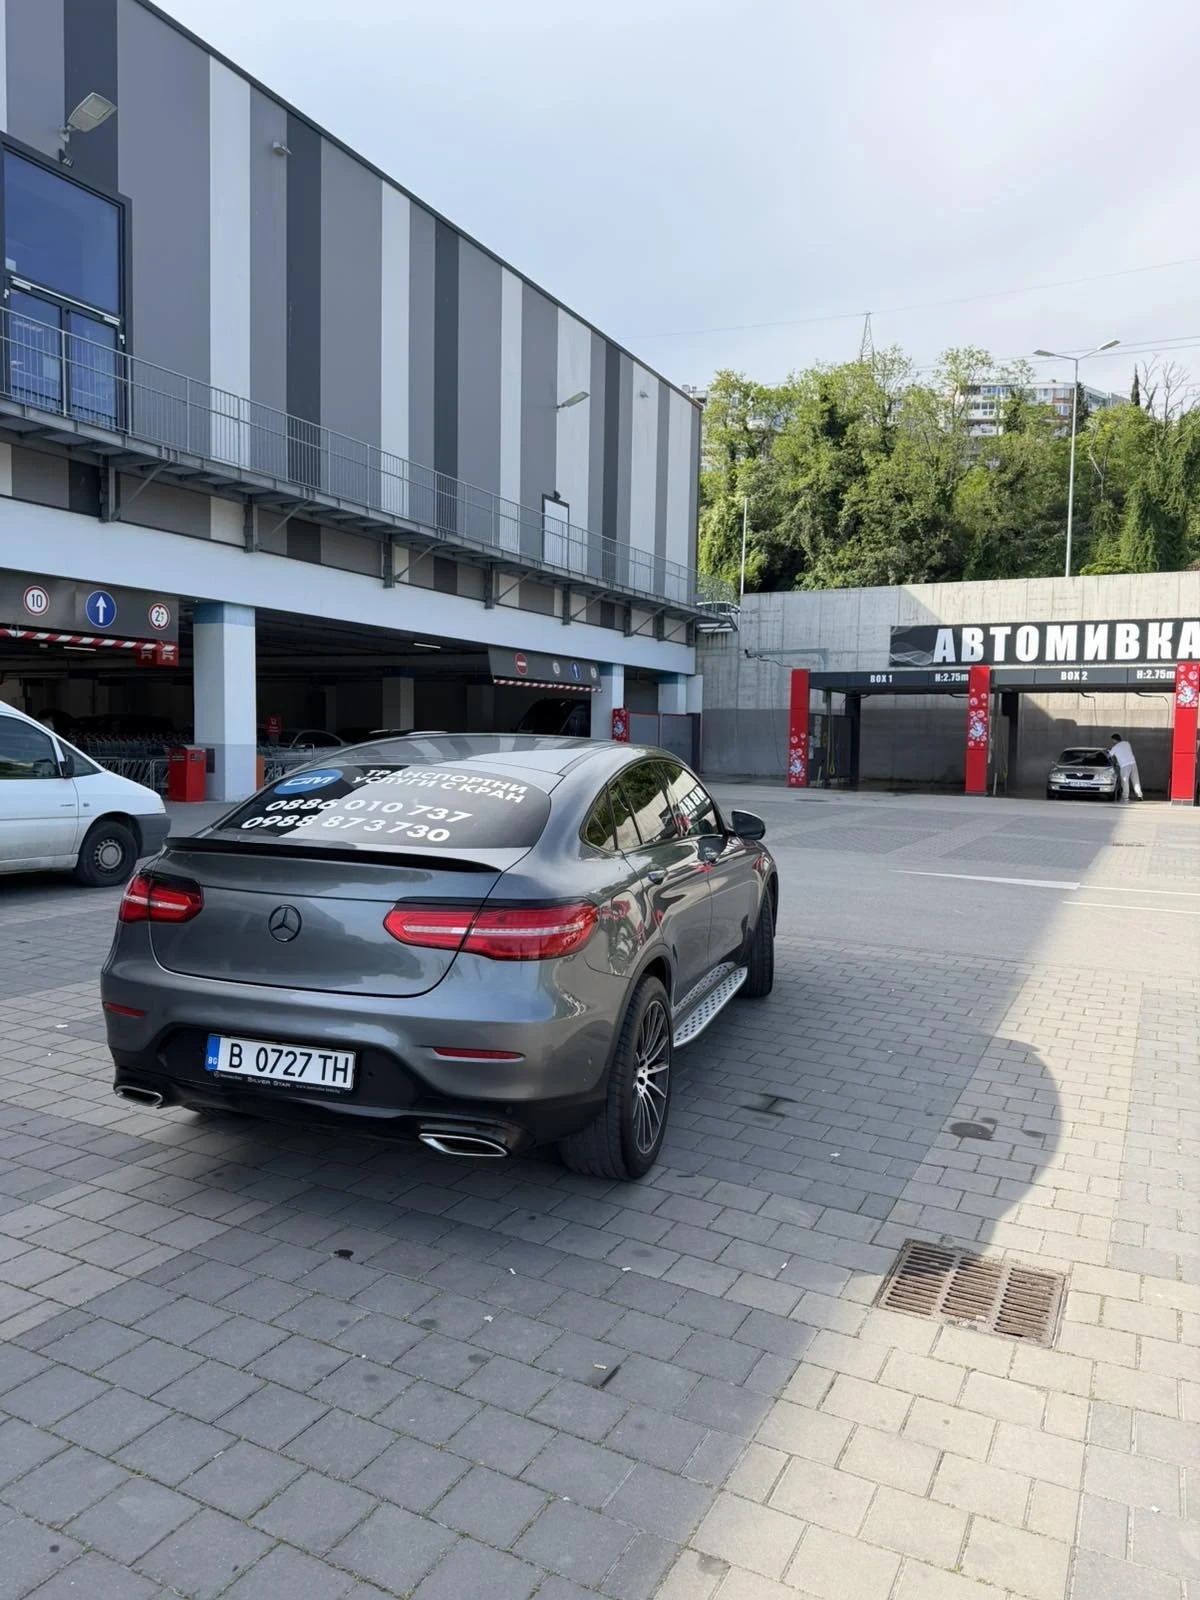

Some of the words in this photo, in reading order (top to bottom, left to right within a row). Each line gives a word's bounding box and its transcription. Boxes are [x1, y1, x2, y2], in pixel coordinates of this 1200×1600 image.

[32, 593, 43, 608] 10
[933, 621, 1200, 663] АВТОМИВКА
[870, 674, 888, 683] BOX
[935, 673, 969, 682] H:2.75m
[1060, 671, 1080, 681] BOX
[1081, 671, 1088, 680] 2
[1136, 669, 1176, 680] H:2.75m
[352, 776, 439, 789] УСЛУГИ
[457, 784, 525, 803] КРАН
[366, 769, 529, 794] ТРАНСПОРТНИ
[265, 798, 339, 812] 0886
[344, 799, 404, 813] 010
[407, 804, 473, 823] 737
[241, 814, 318, 829] 0988
[321, 815, 386, 832] 873
[386, 821, 450, 842] 730
[208, 1055, 218, 1065] BG
[229, 1042, 243, 1068] B
[255, 1047, 313, 1078] 0727
[318, 1054, 350, 1083] TH
